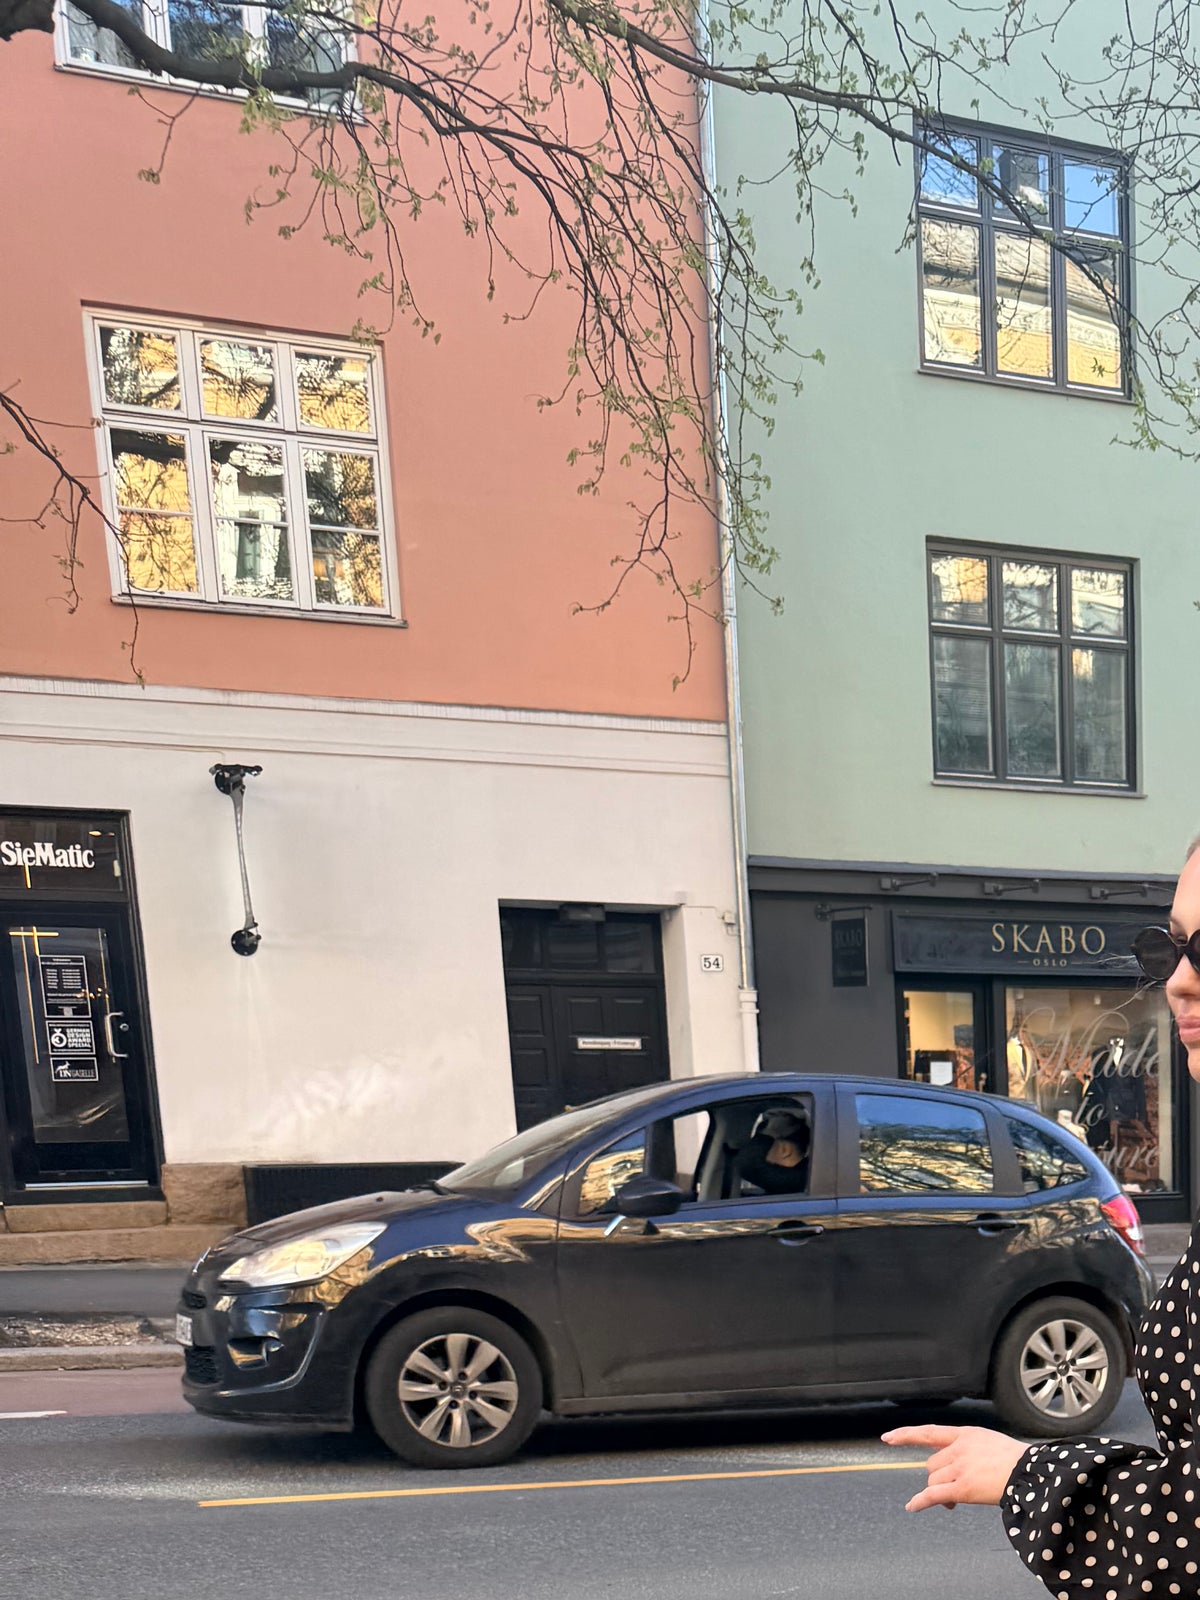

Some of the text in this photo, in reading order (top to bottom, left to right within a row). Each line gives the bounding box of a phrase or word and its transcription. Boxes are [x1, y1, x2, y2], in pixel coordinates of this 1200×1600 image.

[0, 840, 95, 868] SieMatic
[991, 922, 1106, 955] SKABO
[703, 957, 721, 969] 54
[1032, 958, 1068, 967] OSLO
